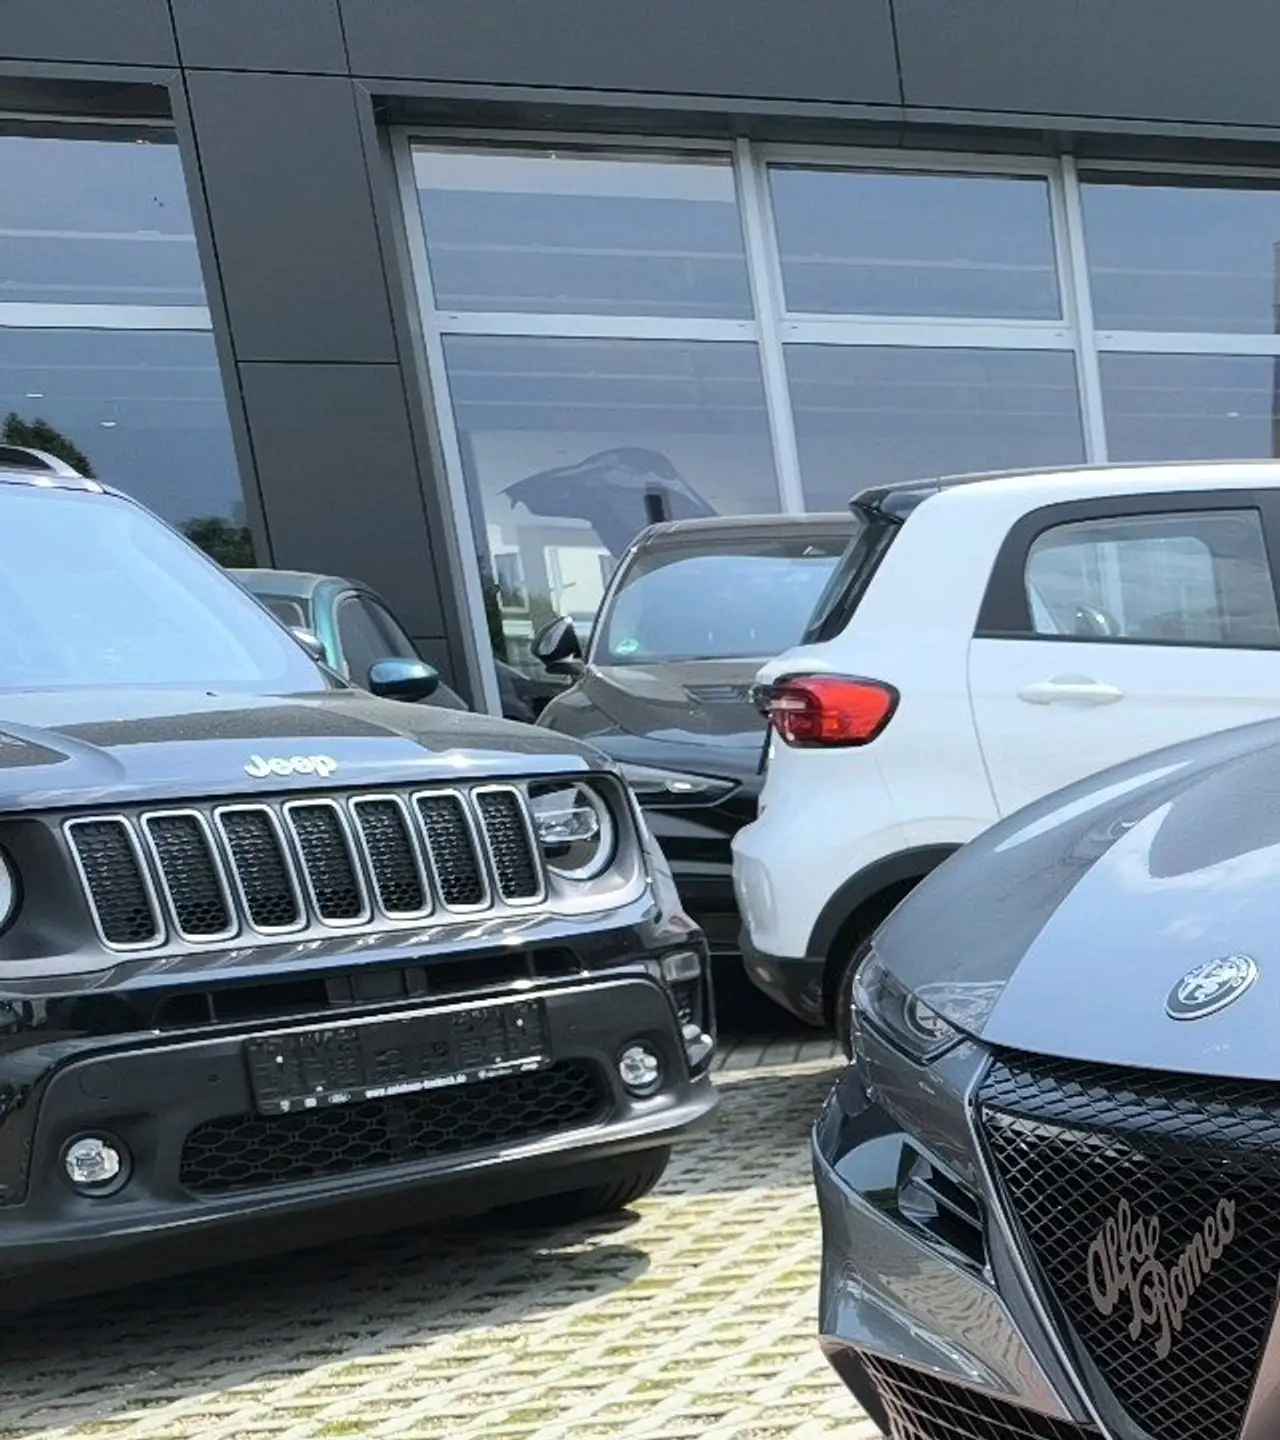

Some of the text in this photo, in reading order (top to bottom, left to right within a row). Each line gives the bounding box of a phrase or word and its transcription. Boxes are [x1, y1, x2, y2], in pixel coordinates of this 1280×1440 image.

[244, 754, 338, 780] Jeep
[1087, 1198, 1237, 1361] Alfa Romeo
